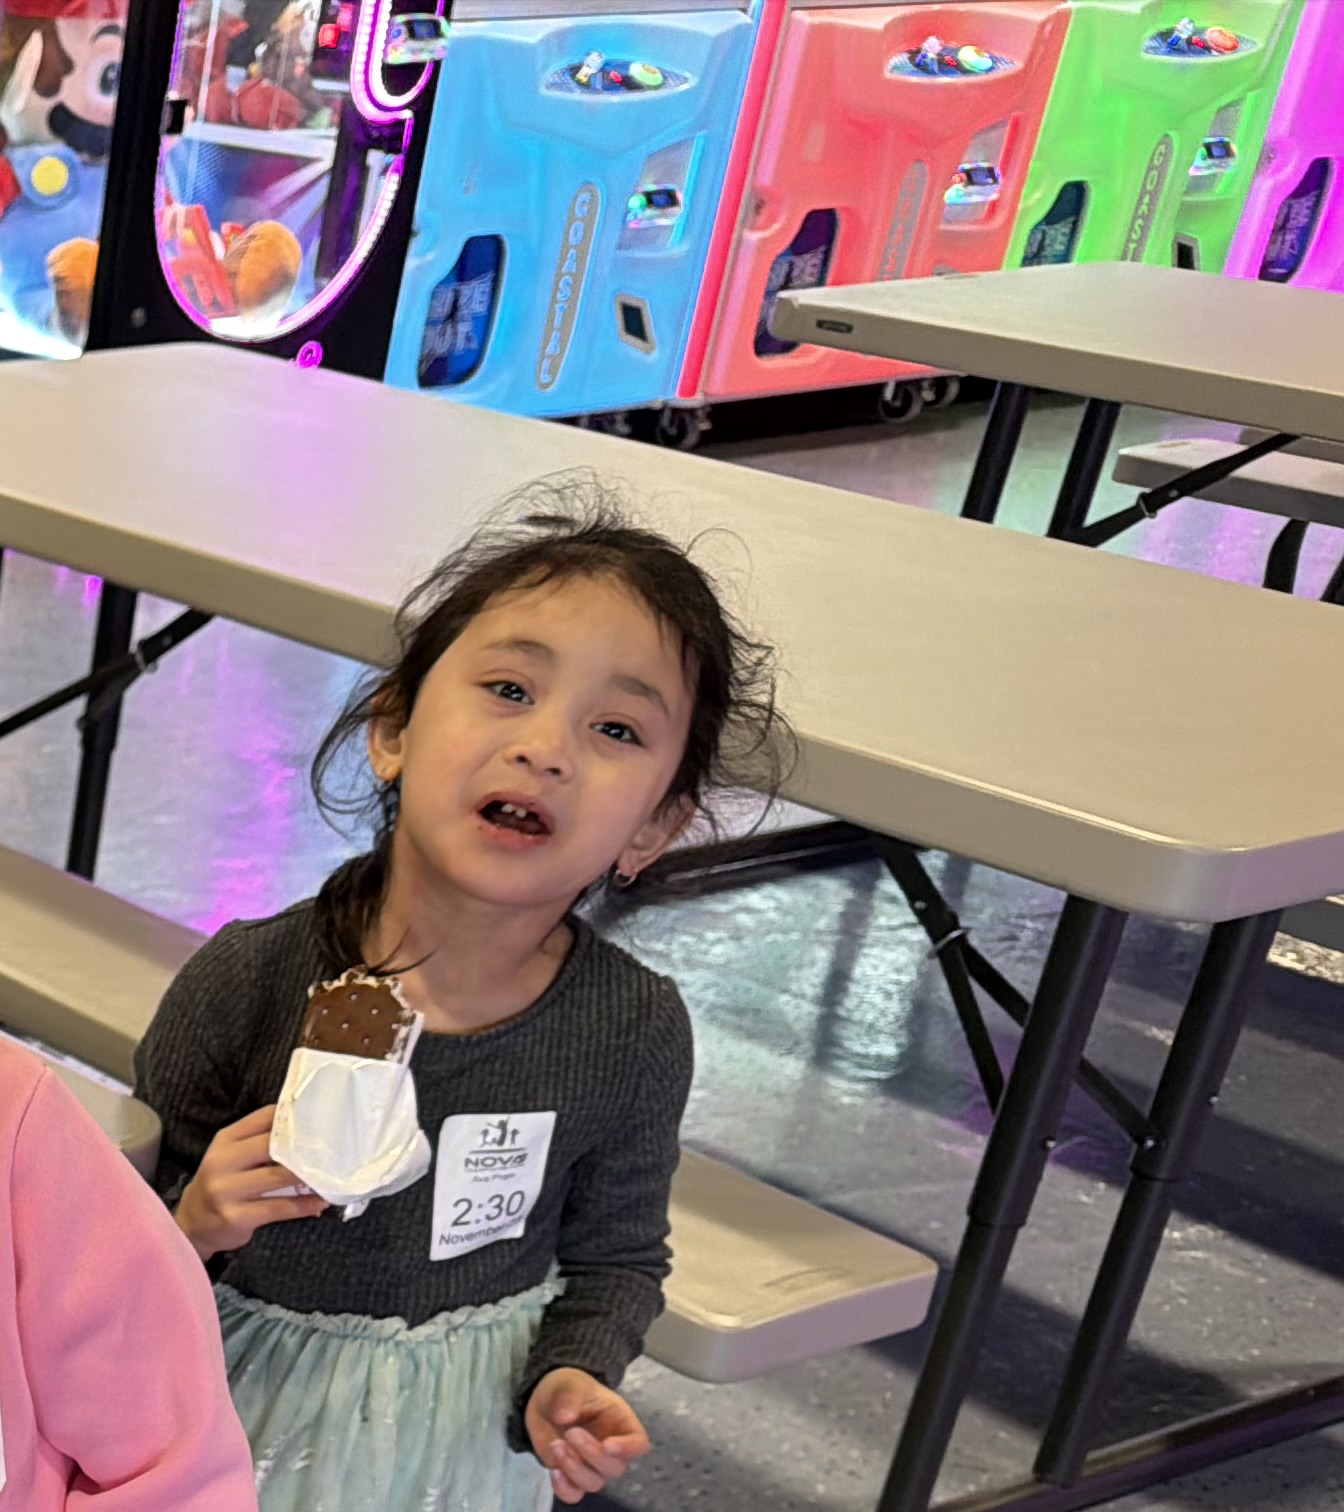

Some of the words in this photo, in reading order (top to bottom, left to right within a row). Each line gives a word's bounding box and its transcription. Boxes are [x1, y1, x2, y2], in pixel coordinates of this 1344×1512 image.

[1125, 143, 1167, 262] COAST
[540, 191, 592, 383] COASTAL
[464, 1153, 528, 1168] NOVA
[450, 1190, 525, 1228] 2:30
